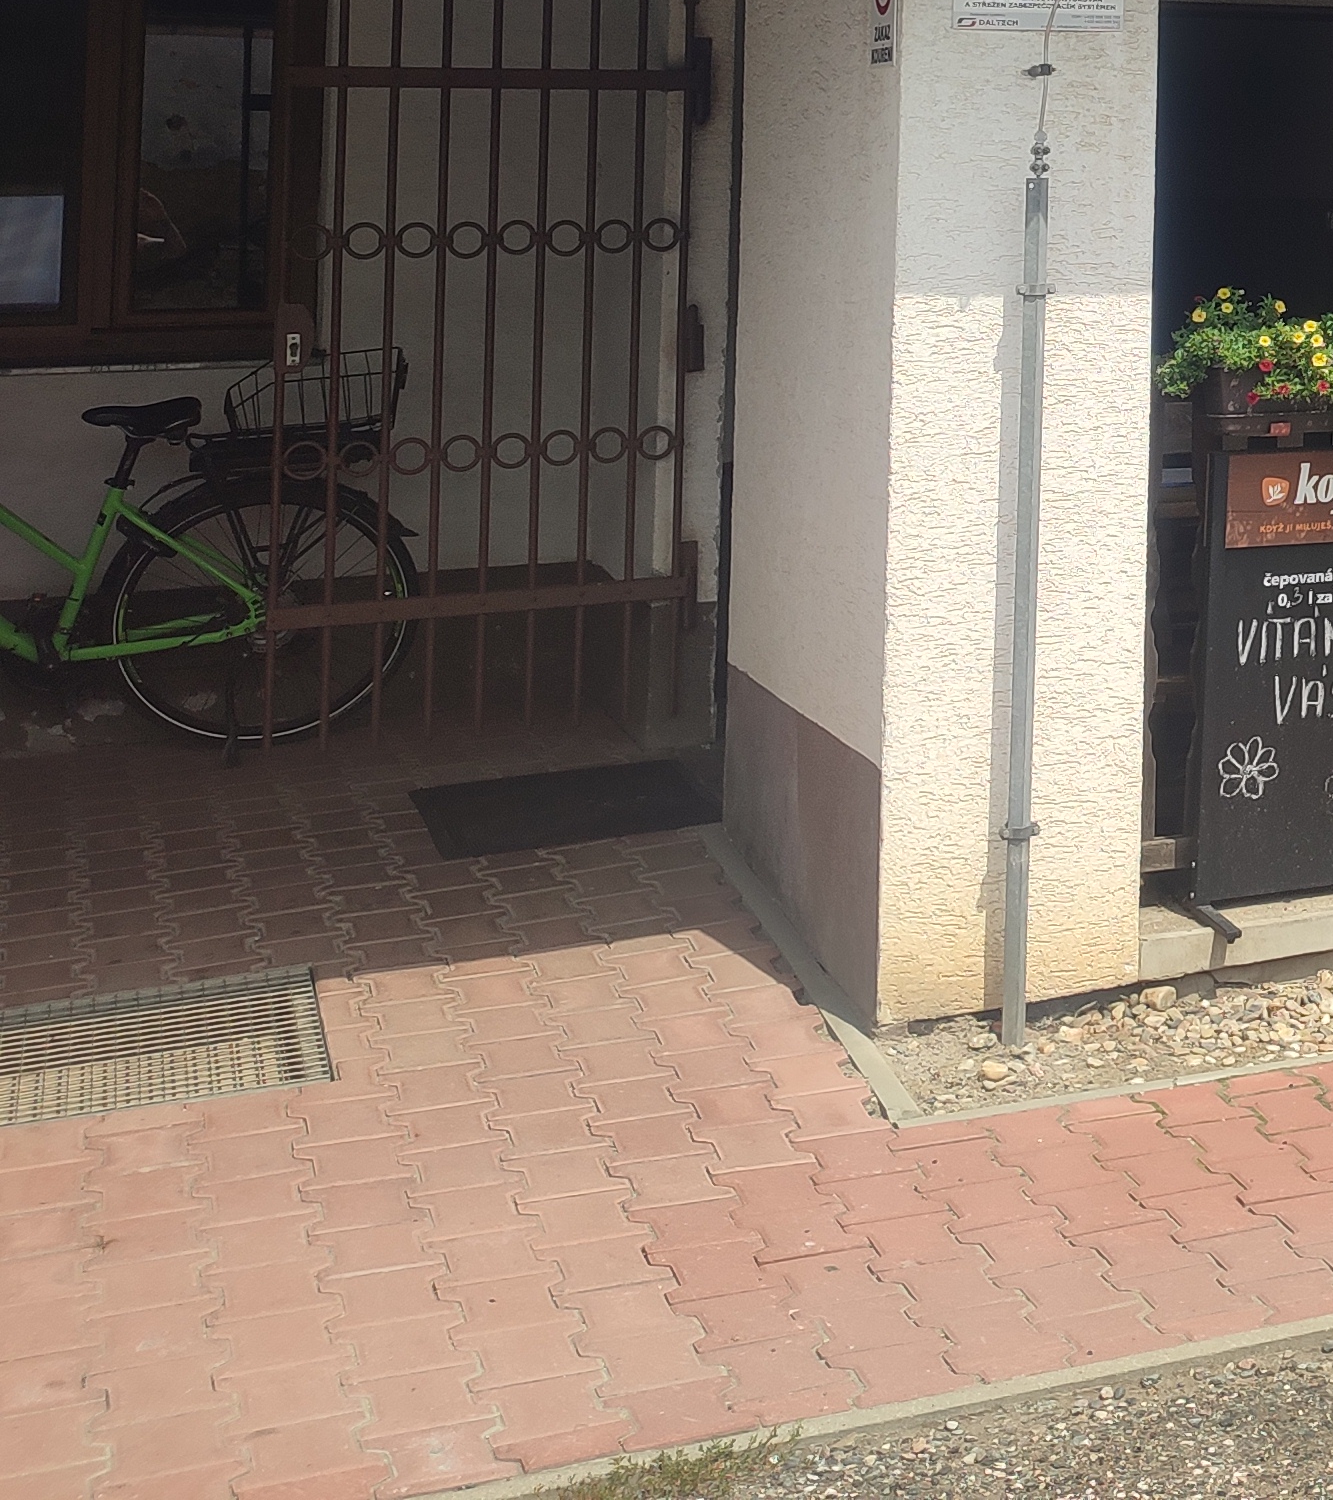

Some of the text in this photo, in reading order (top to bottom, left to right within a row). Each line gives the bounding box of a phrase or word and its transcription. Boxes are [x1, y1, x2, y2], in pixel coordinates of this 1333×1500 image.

[1259, 521, 1284, 534] KDYŽ
[1285, 523, 1293, 533] JI
[1263, 568, 1333, 590] čepovaná
[1316, 593, 1333, 605] za
